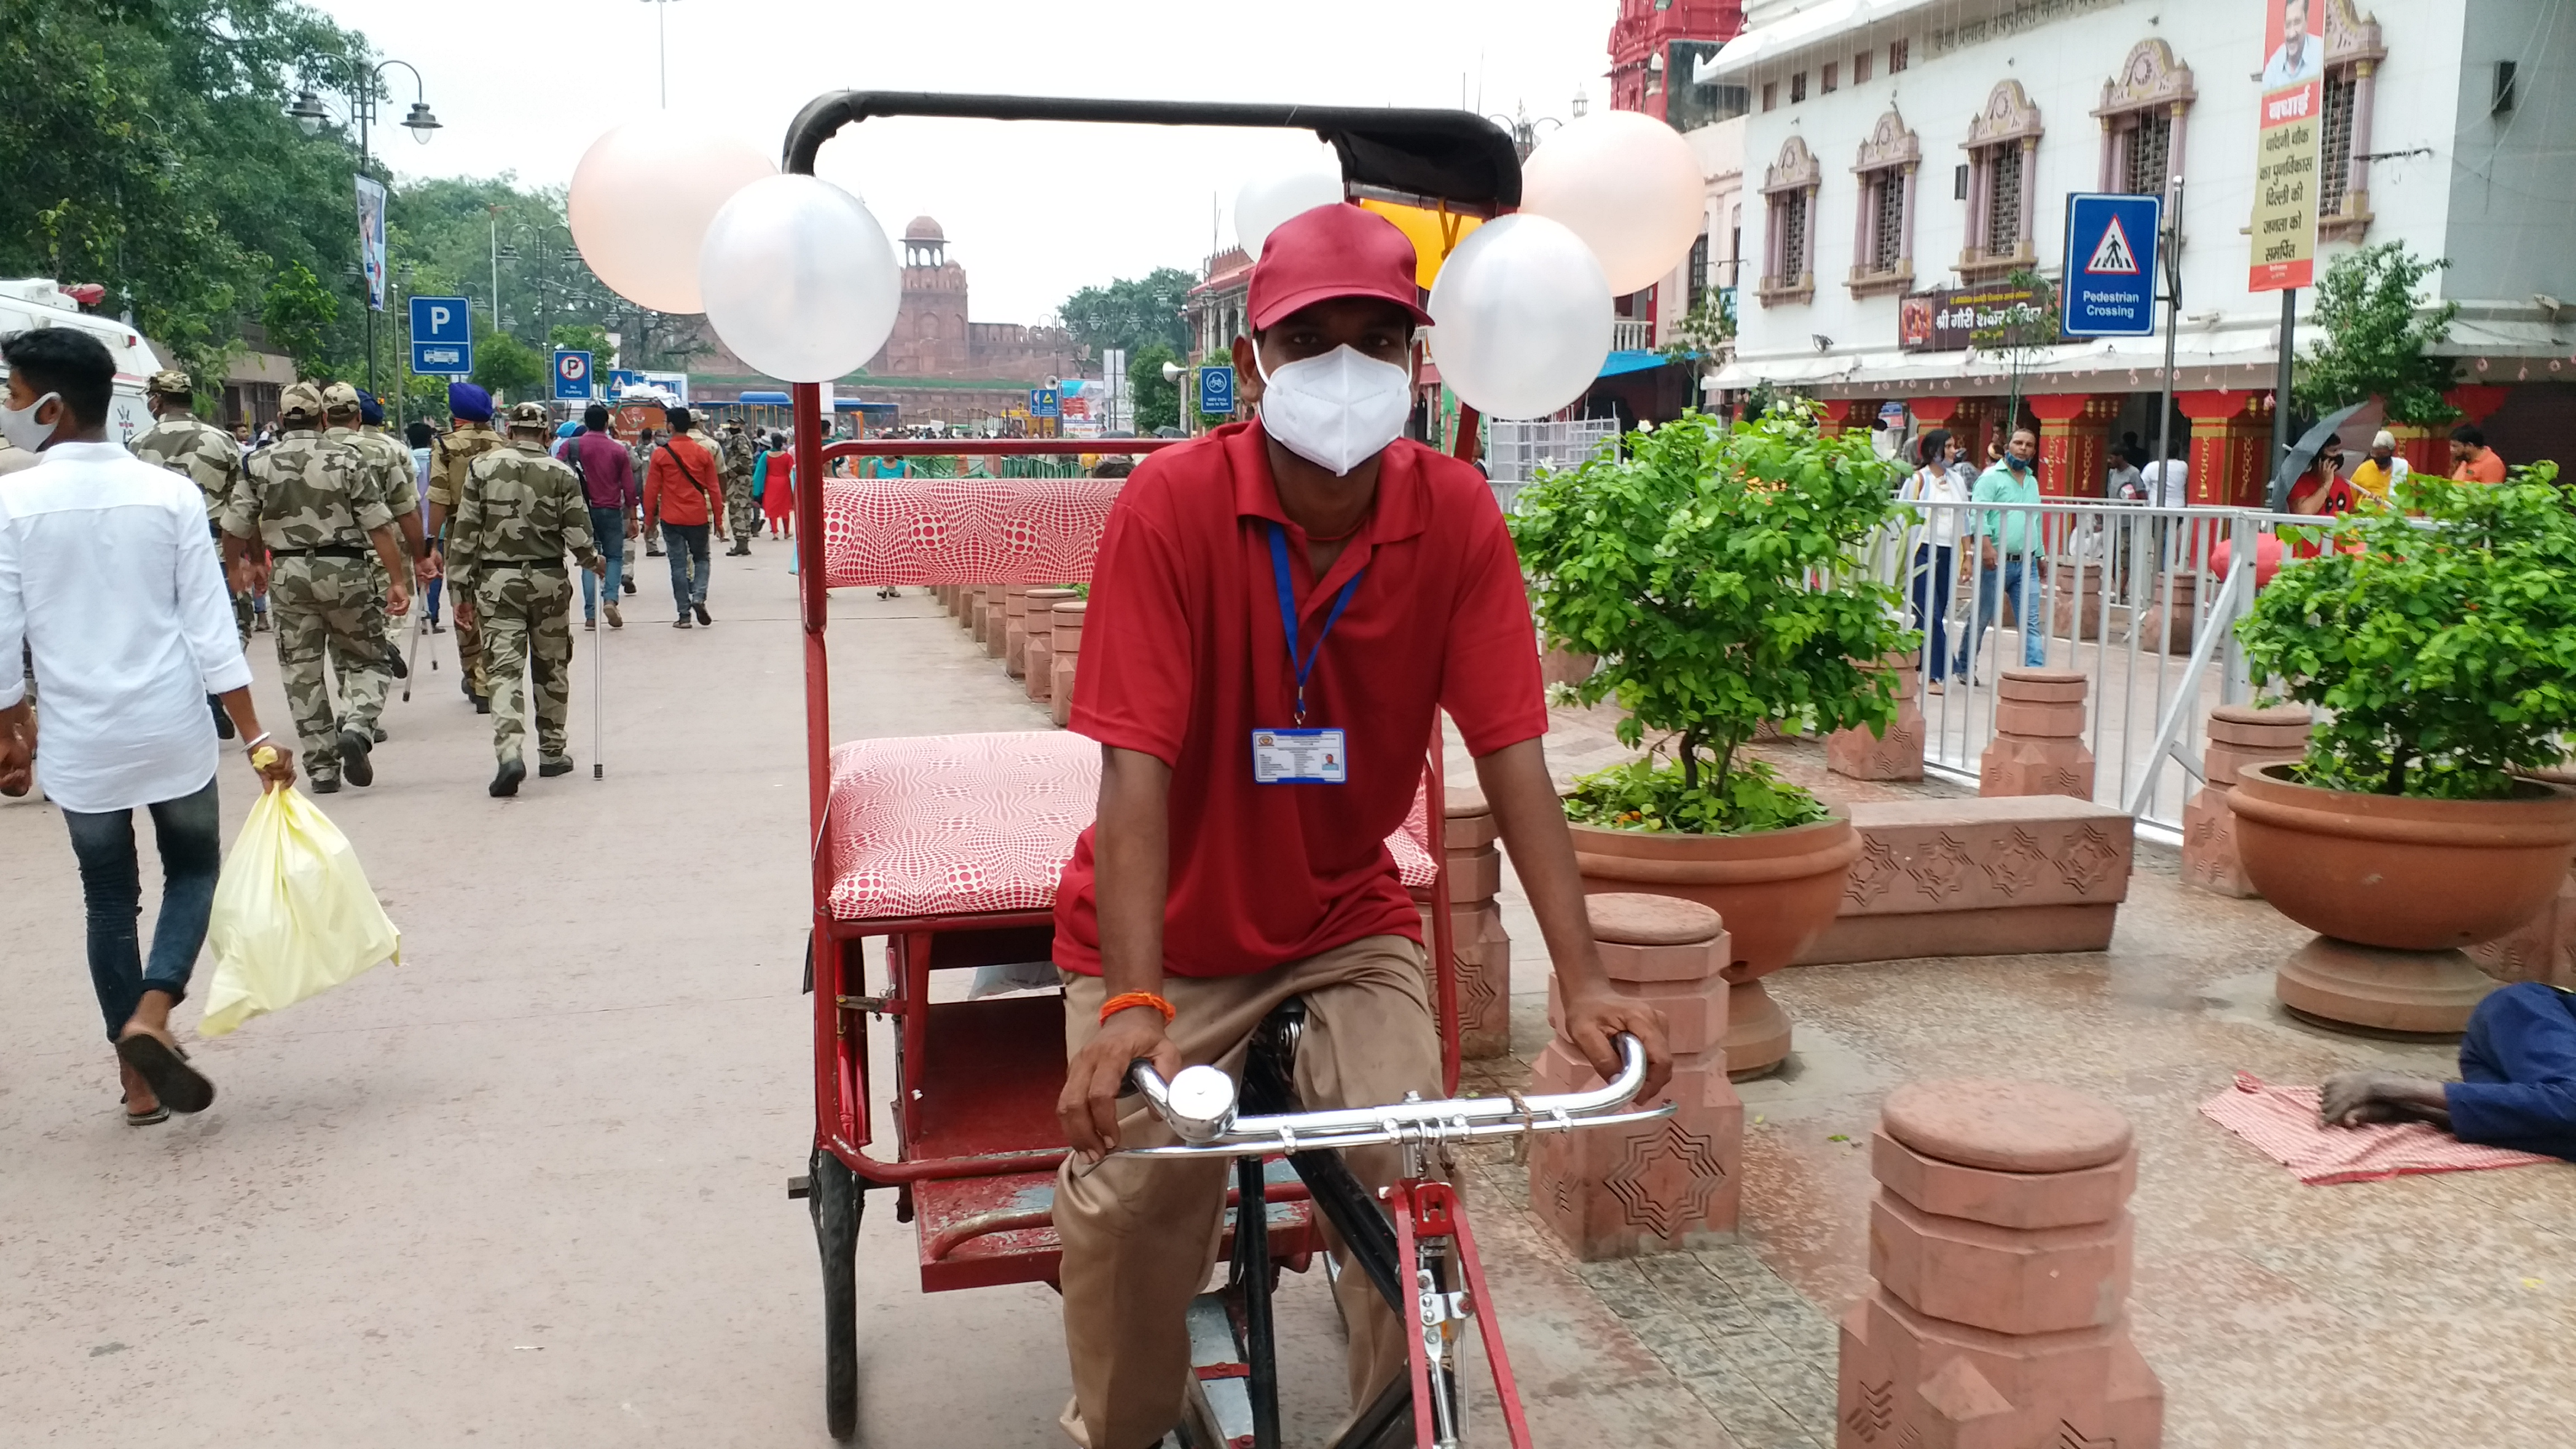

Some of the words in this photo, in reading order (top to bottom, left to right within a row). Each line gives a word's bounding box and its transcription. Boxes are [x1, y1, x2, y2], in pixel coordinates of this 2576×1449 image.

[2269, 84, 2310, 120] बधाई
[2266, 127, 2290, 152] चांदनी
[2292, 125, 2309, 146] चौक
[2260, 165, 2271, 182] का
[2273, 154, 2313, 186] पुनर्विकास
[2266, 184, 2289, 207] दिल्ली
[2291, 180, 2303, 202] की
[2263, 216, 2288, 235] जनता
[2289, 210, 2302, 230] को
[2265, 239, 2296, 262] समर्पित
[2083, 290, 2139, 303] Pedestrian
[430, 306, 451, 334] P
[1936, 309, 1949, 330] श्री
[1951, 306, 1974, 329] गौरी
[2087, 305, 2134, 319] Crossing
